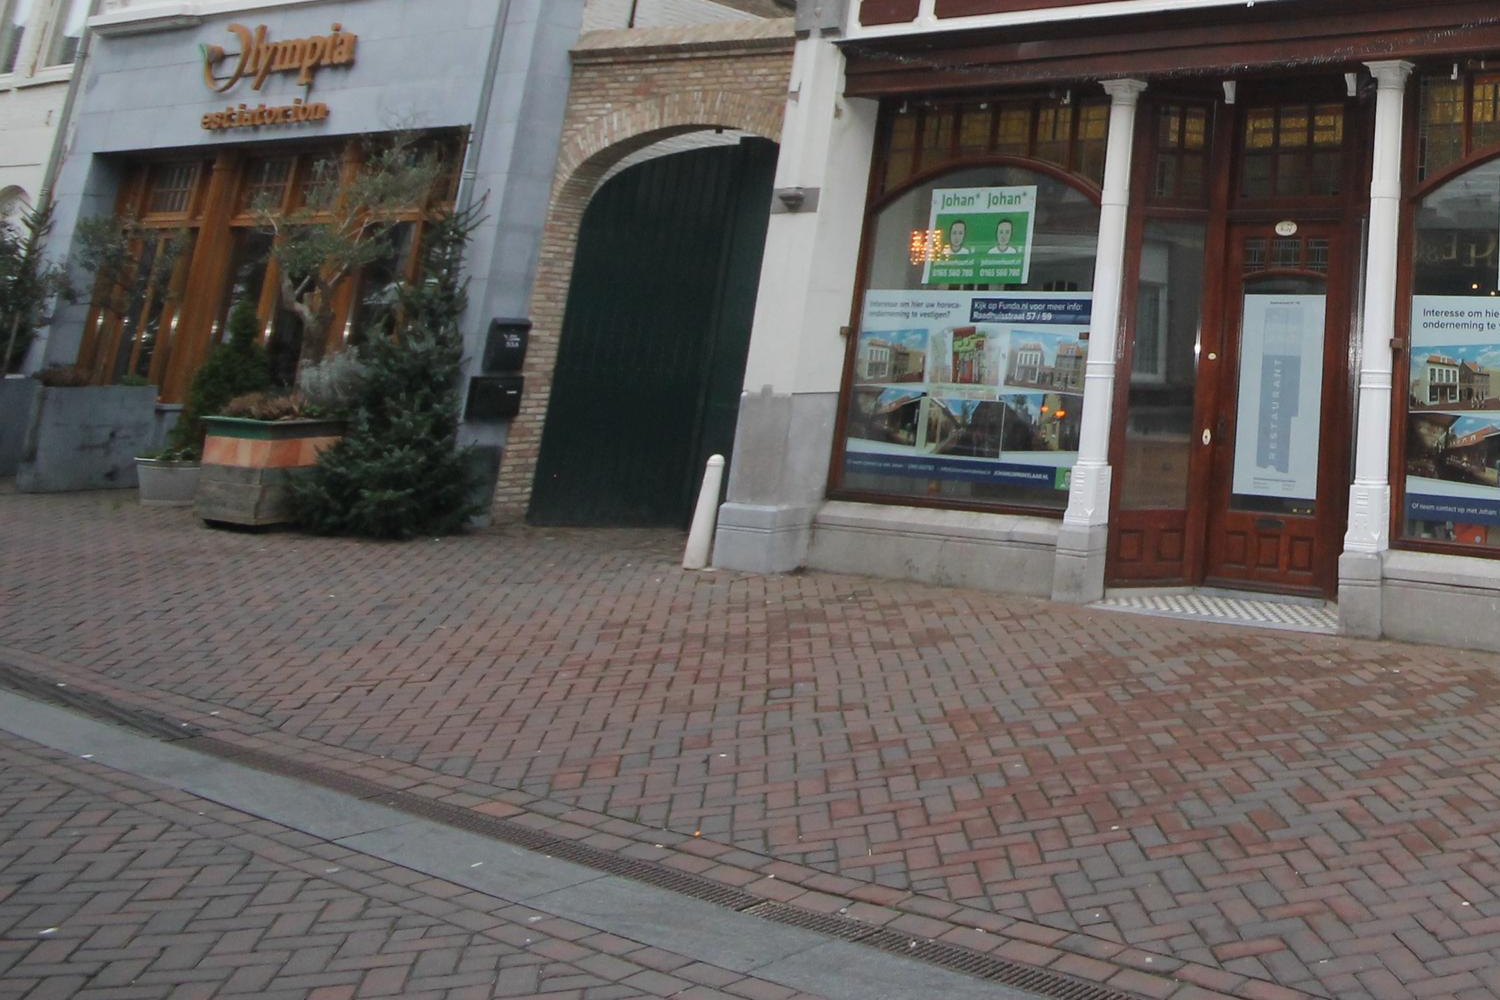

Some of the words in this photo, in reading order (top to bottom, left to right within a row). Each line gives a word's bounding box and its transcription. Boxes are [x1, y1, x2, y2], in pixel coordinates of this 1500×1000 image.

[199, 23, 358, 93] Olympia
[201, 98, 329, 130] estiatorion
[999, 302, 1029, 311] Funda.nl
[1423, 308, 1465, 318] Interesse
[1422, 321, 1484, 332] onderneming
[1486, 321, 1496, 330] te
[1268, 359, 1282, 460] RESTAURANT
